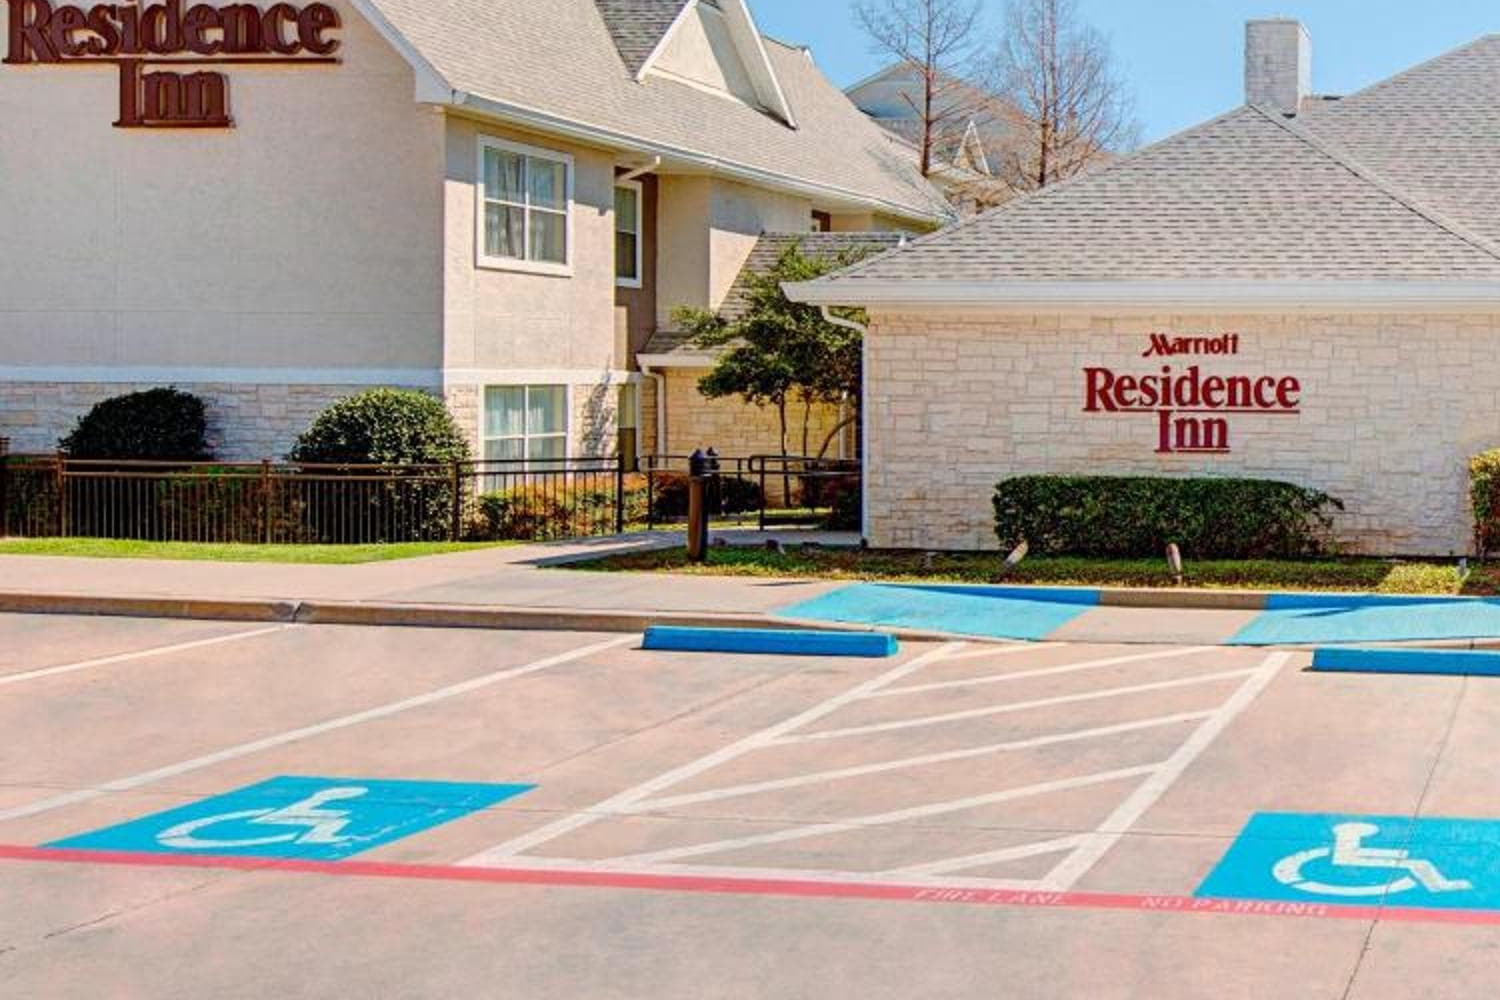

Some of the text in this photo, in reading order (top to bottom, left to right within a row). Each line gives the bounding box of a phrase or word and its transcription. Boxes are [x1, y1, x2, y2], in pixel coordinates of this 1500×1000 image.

[112, 59, 236, 129] Inn
[1142, 333, 1239, 358] Marriott
[1082, 365, 1300, 413] Residence
[1154, 409, 1230, 453] Inn
[1141, 895, 1328, 917] NO PARKING
